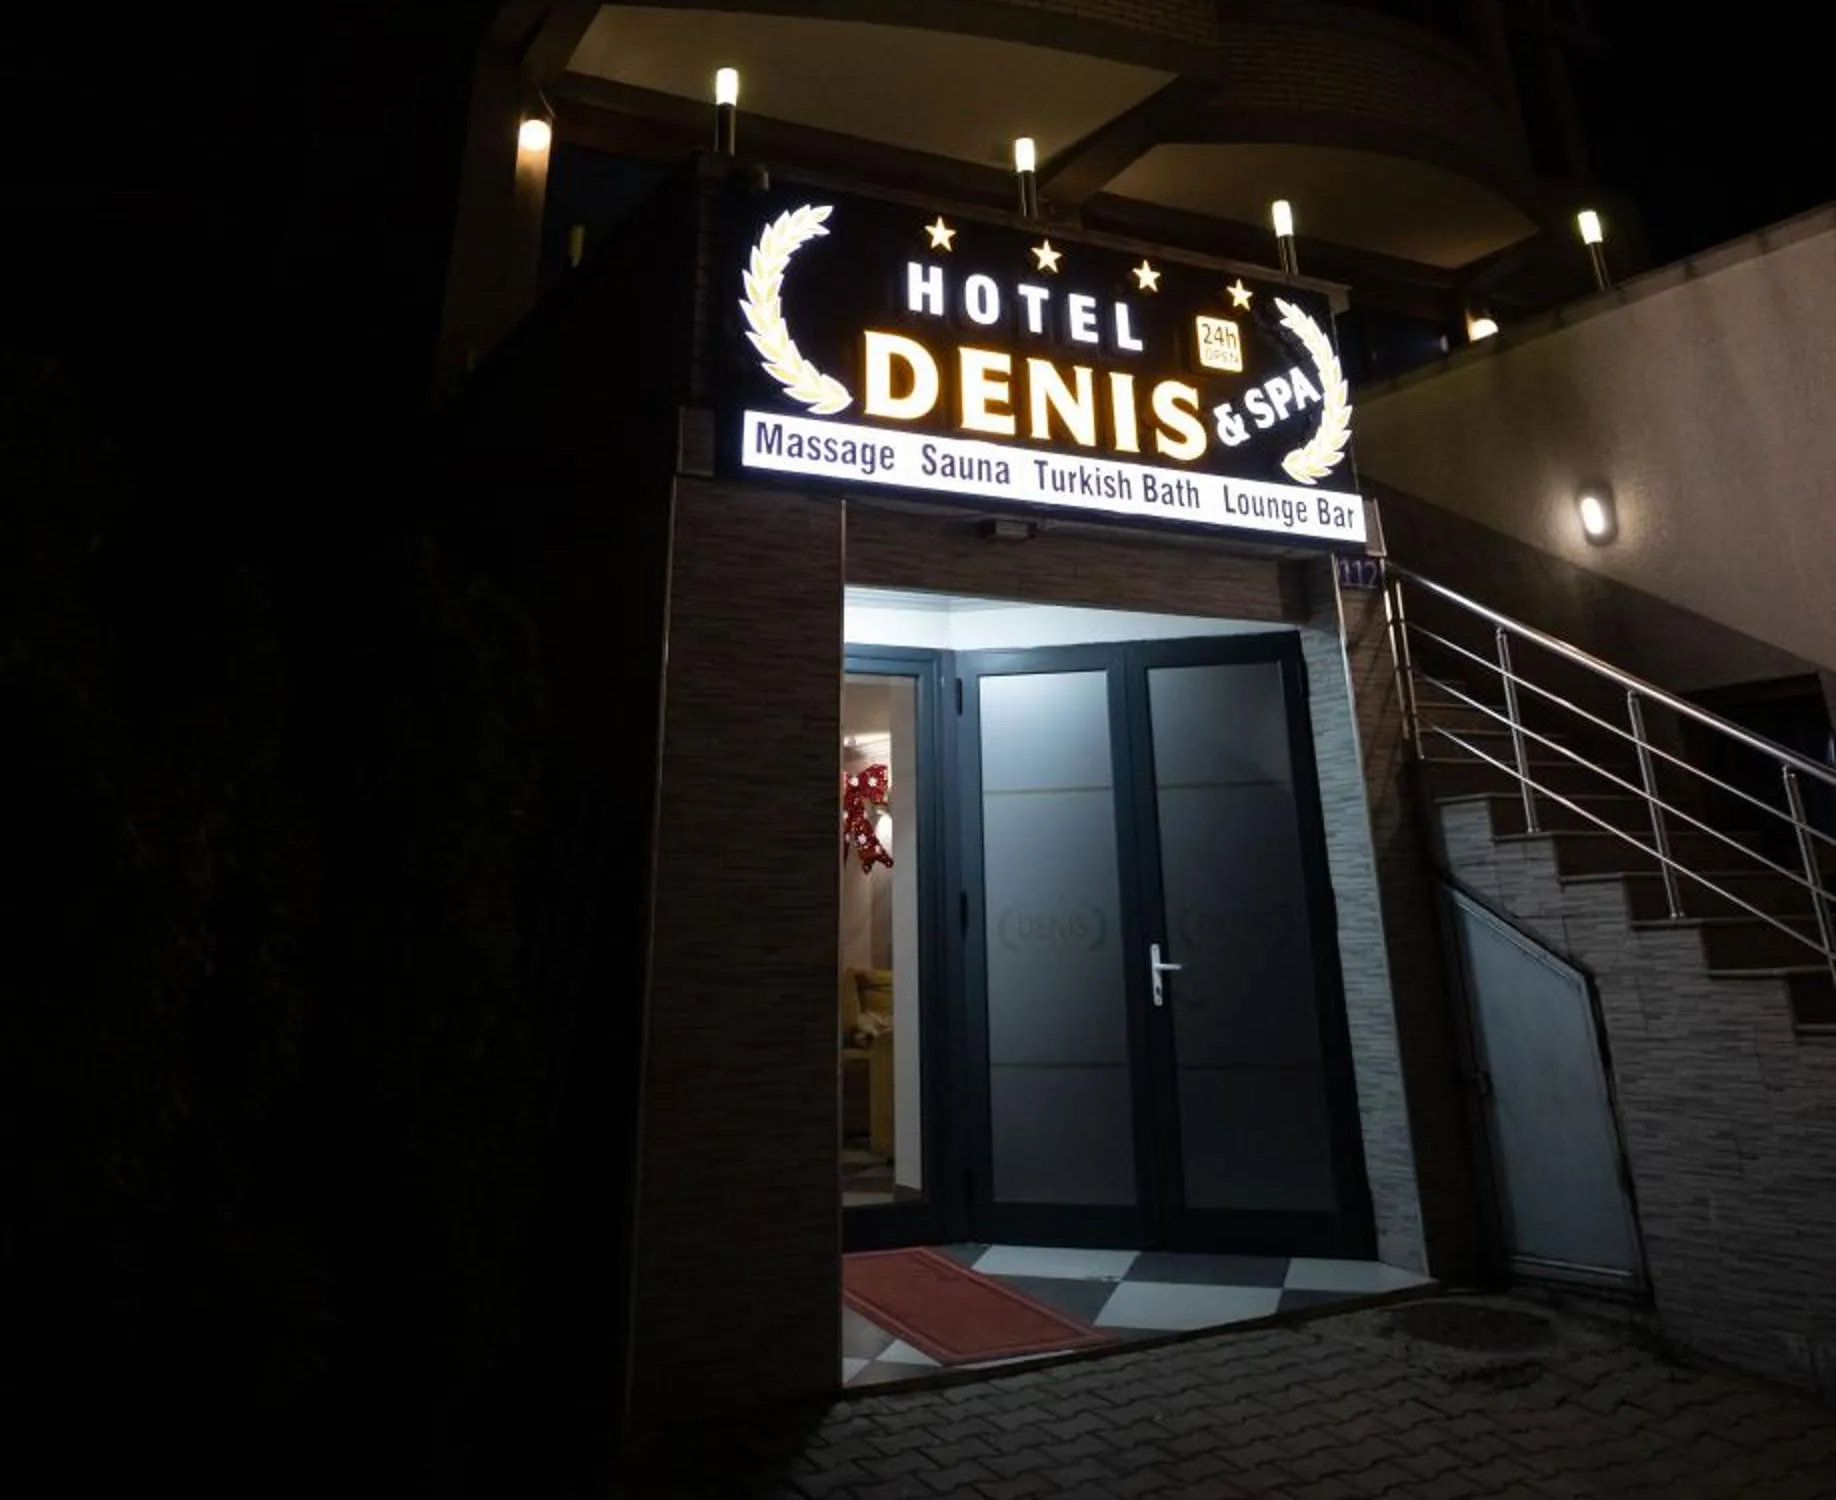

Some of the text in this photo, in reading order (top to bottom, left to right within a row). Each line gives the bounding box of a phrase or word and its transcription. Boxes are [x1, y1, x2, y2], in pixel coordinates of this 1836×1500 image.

[907, 261, 1144, 351] HOTEL
[1201, 323, 1238, 349] 24h
[864, 330, 1207, 461] DENIS
[1213, 366, 1322, 446] & SPA
[755, 421, 1354, 529] Massage Sauna Turkish Bath Lounge Bar
